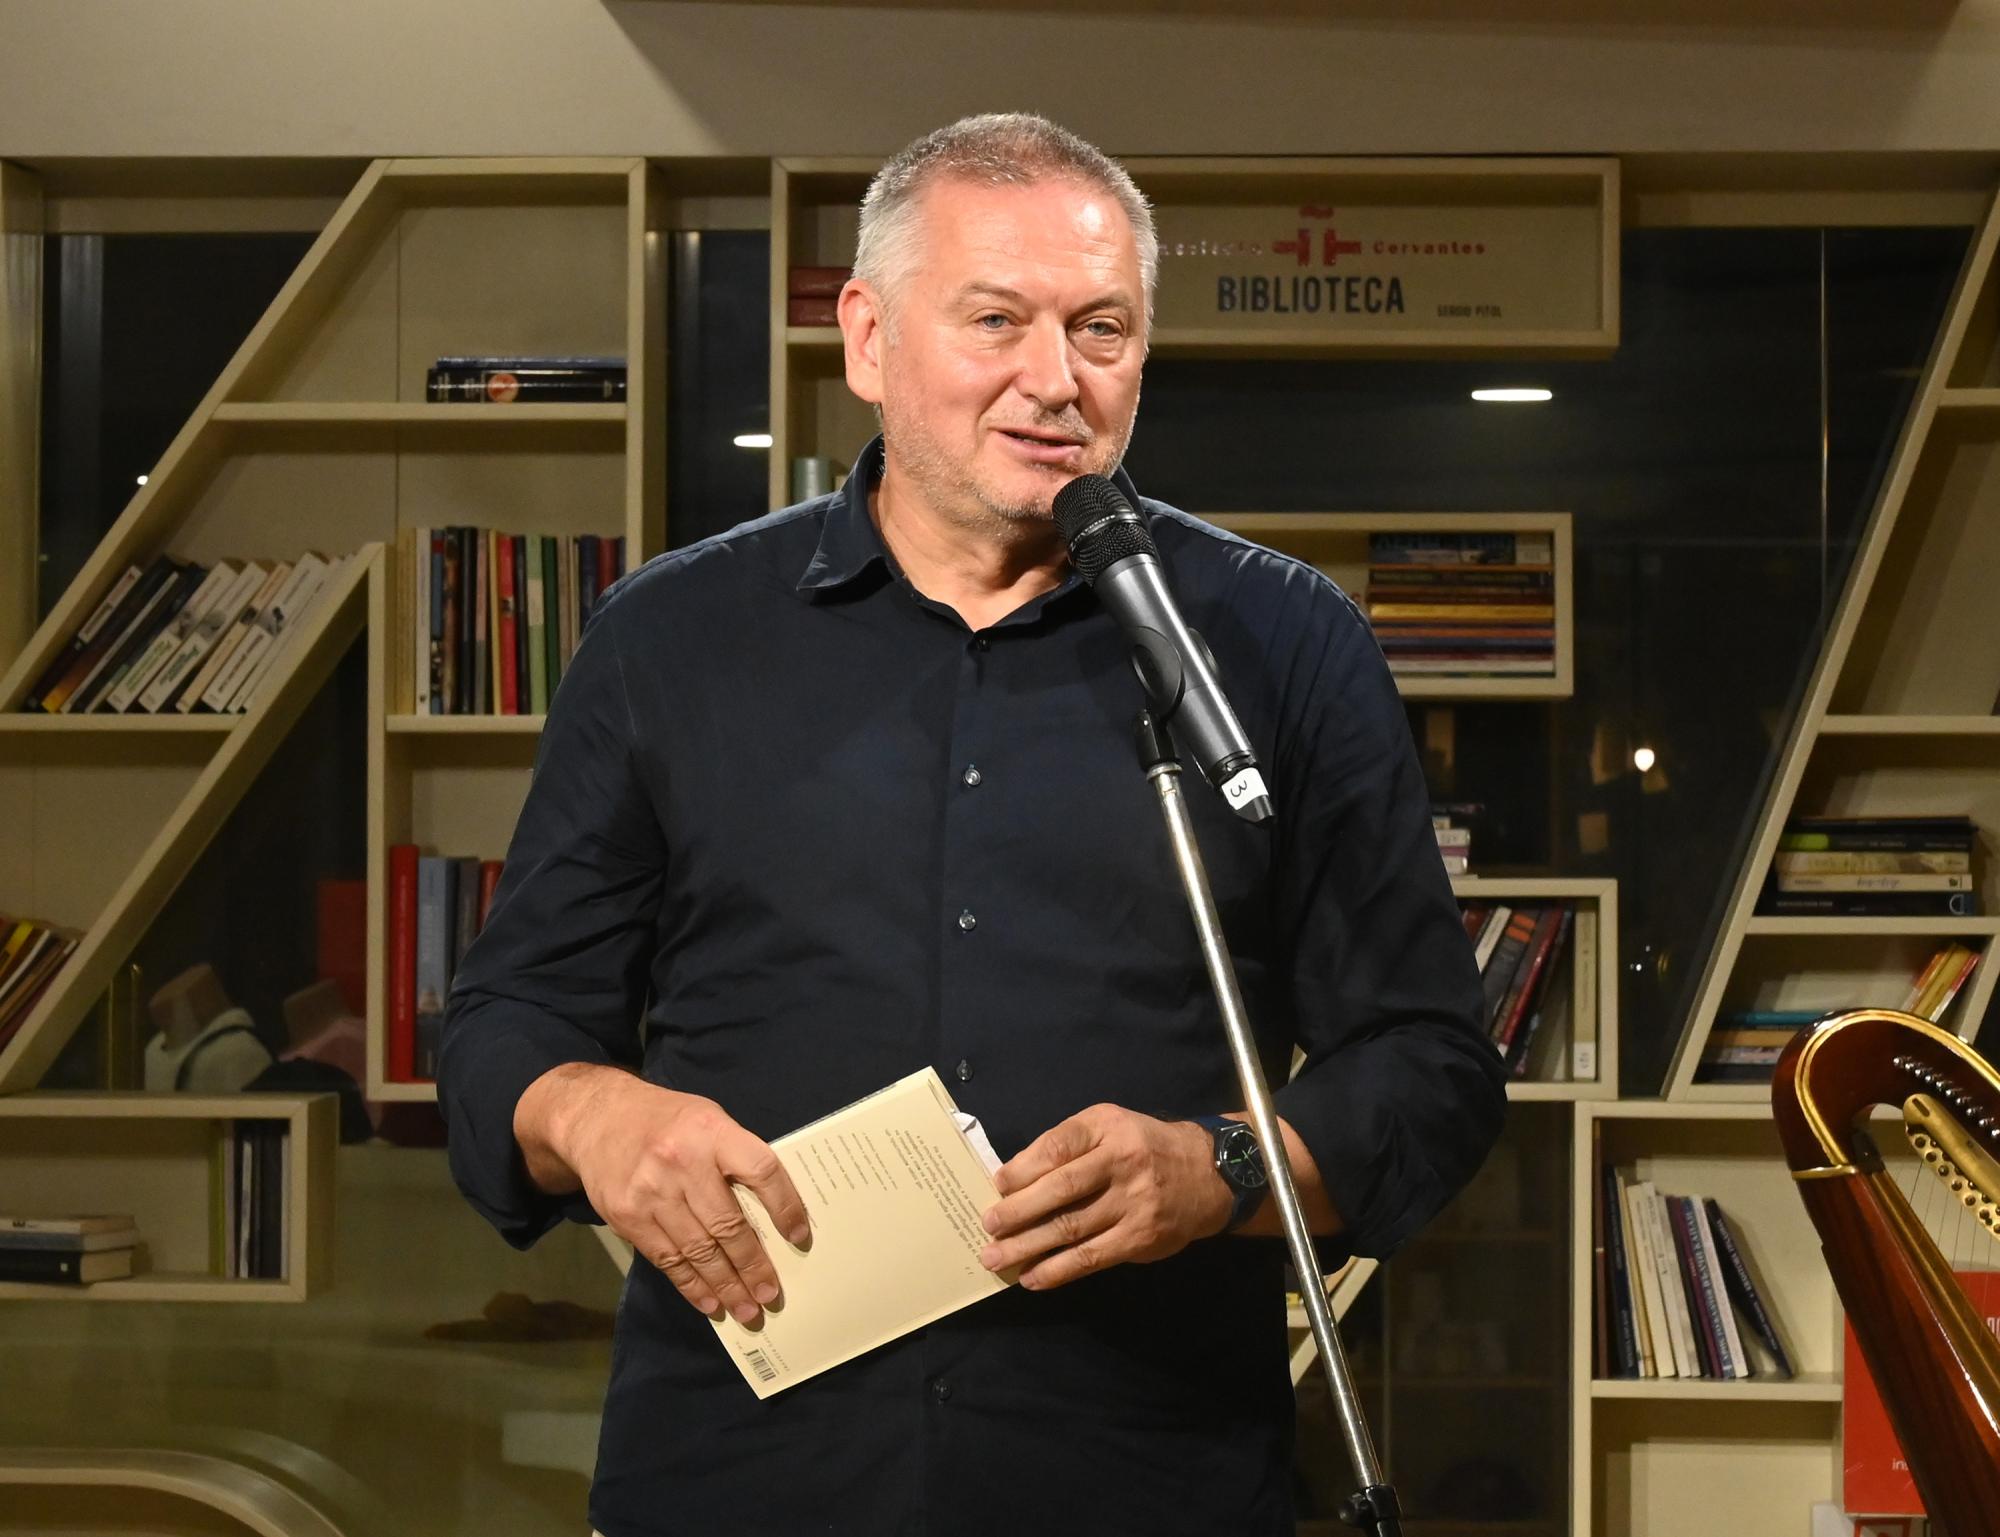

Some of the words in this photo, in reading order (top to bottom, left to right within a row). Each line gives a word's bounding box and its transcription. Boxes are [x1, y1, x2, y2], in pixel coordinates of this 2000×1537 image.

[1373, 241, 1486, 255] Cervantes
[1217, 275, 1406, 314] BIBLIOTECA
[1230, 780, 1248, 798] 3
